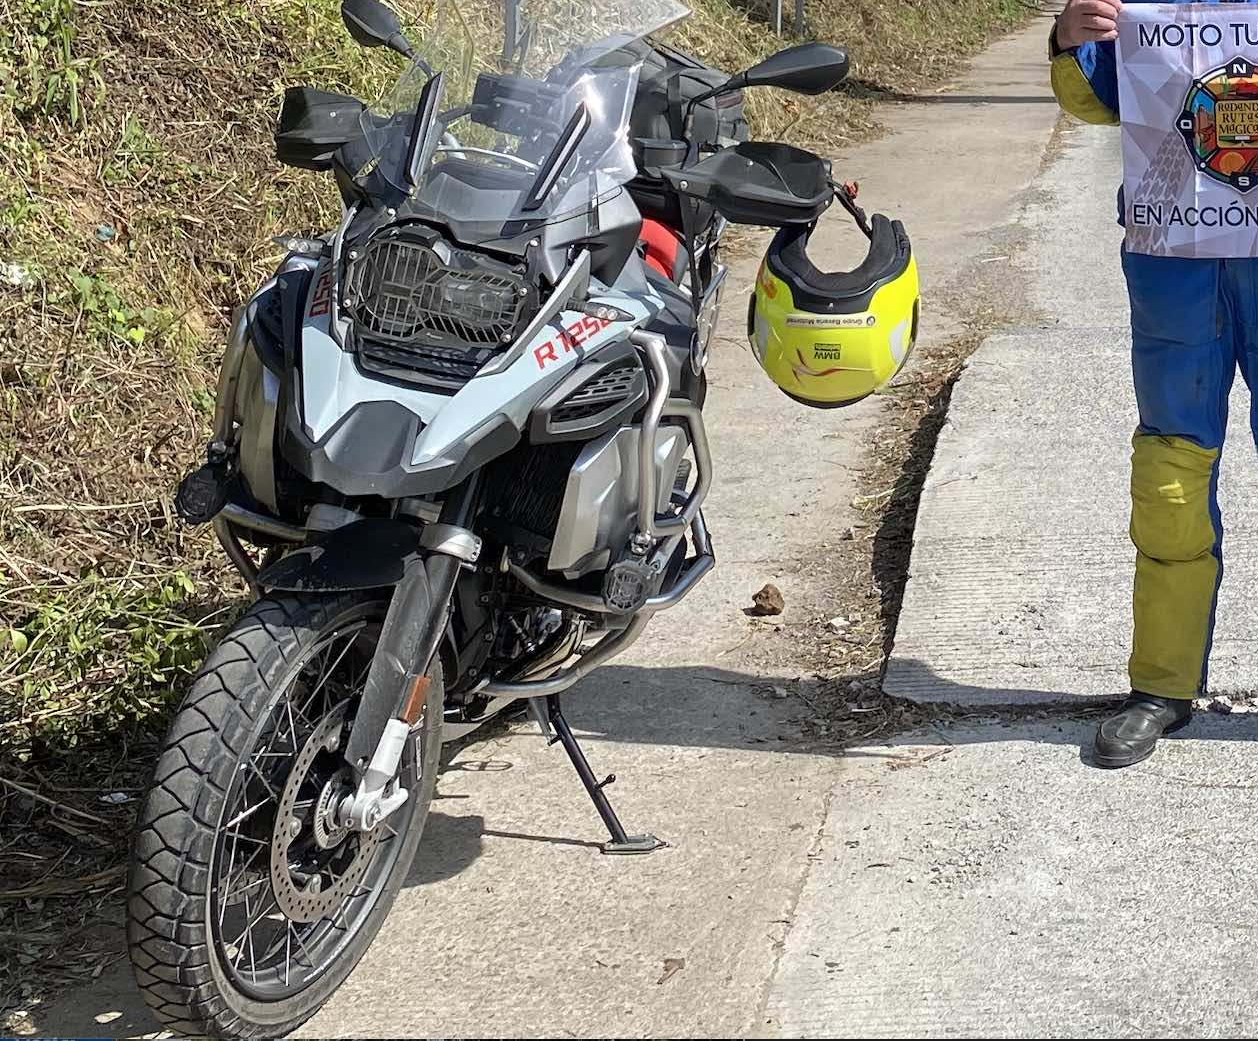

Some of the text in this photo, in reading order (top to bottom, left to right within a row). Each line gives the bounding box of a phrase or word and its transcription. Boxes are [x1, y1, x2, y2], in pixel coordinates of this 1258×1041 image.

[1139, 23, 1222, 47] MOTO
[1232, 63, 1247, 74] N
[1238, 175, 1250, 186] S
[1133, 204, 1162, 226] EN
[842, 318, 863, 326] Grupo
[533, 341, 559, 369] R
[813, 351, 841, 360] BMW
